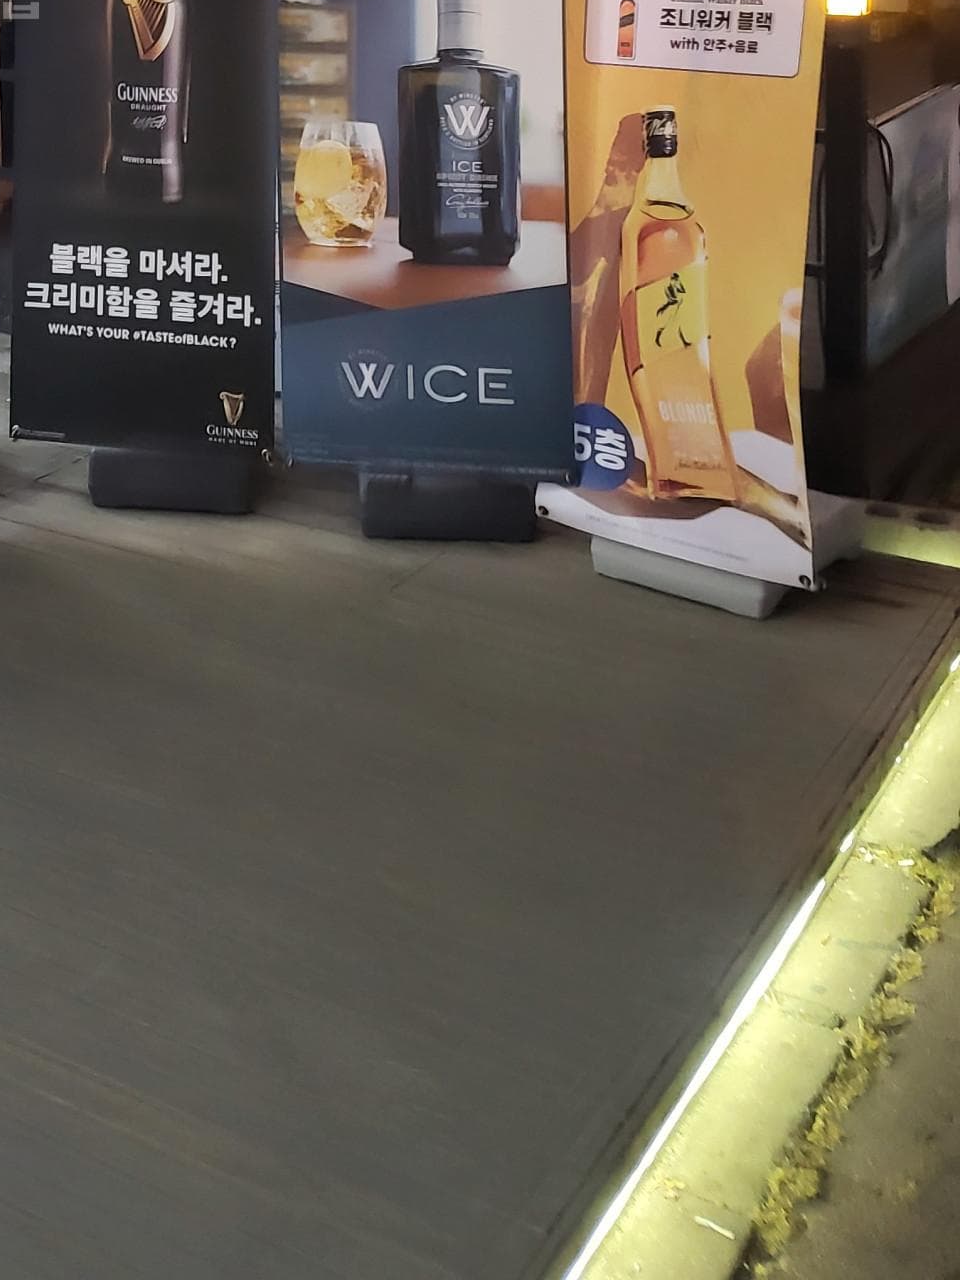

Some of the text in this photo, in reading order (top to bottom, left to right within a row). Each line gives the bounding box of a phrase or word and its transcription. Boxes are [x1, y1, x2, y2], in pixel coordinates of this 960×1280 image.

[659, 8, 773, 32] 조니워커 블랙
[670, 37, 759, 54] with 안주+음료
[117, 82, 178, 103] GUINNESS
[452, 161, 483, 173] ICE
[49, 243, 228, 285] 블랙을 마셔라.
[24, 282, 262, 328] 크리미함을 즐겨라.
[48, 323, 94, 338] WHAT'S
[96, 326, 130, 340] YOUR
[206, 424, 259, 439] GUINNESS
[574, 423, 627, 470] 5층
